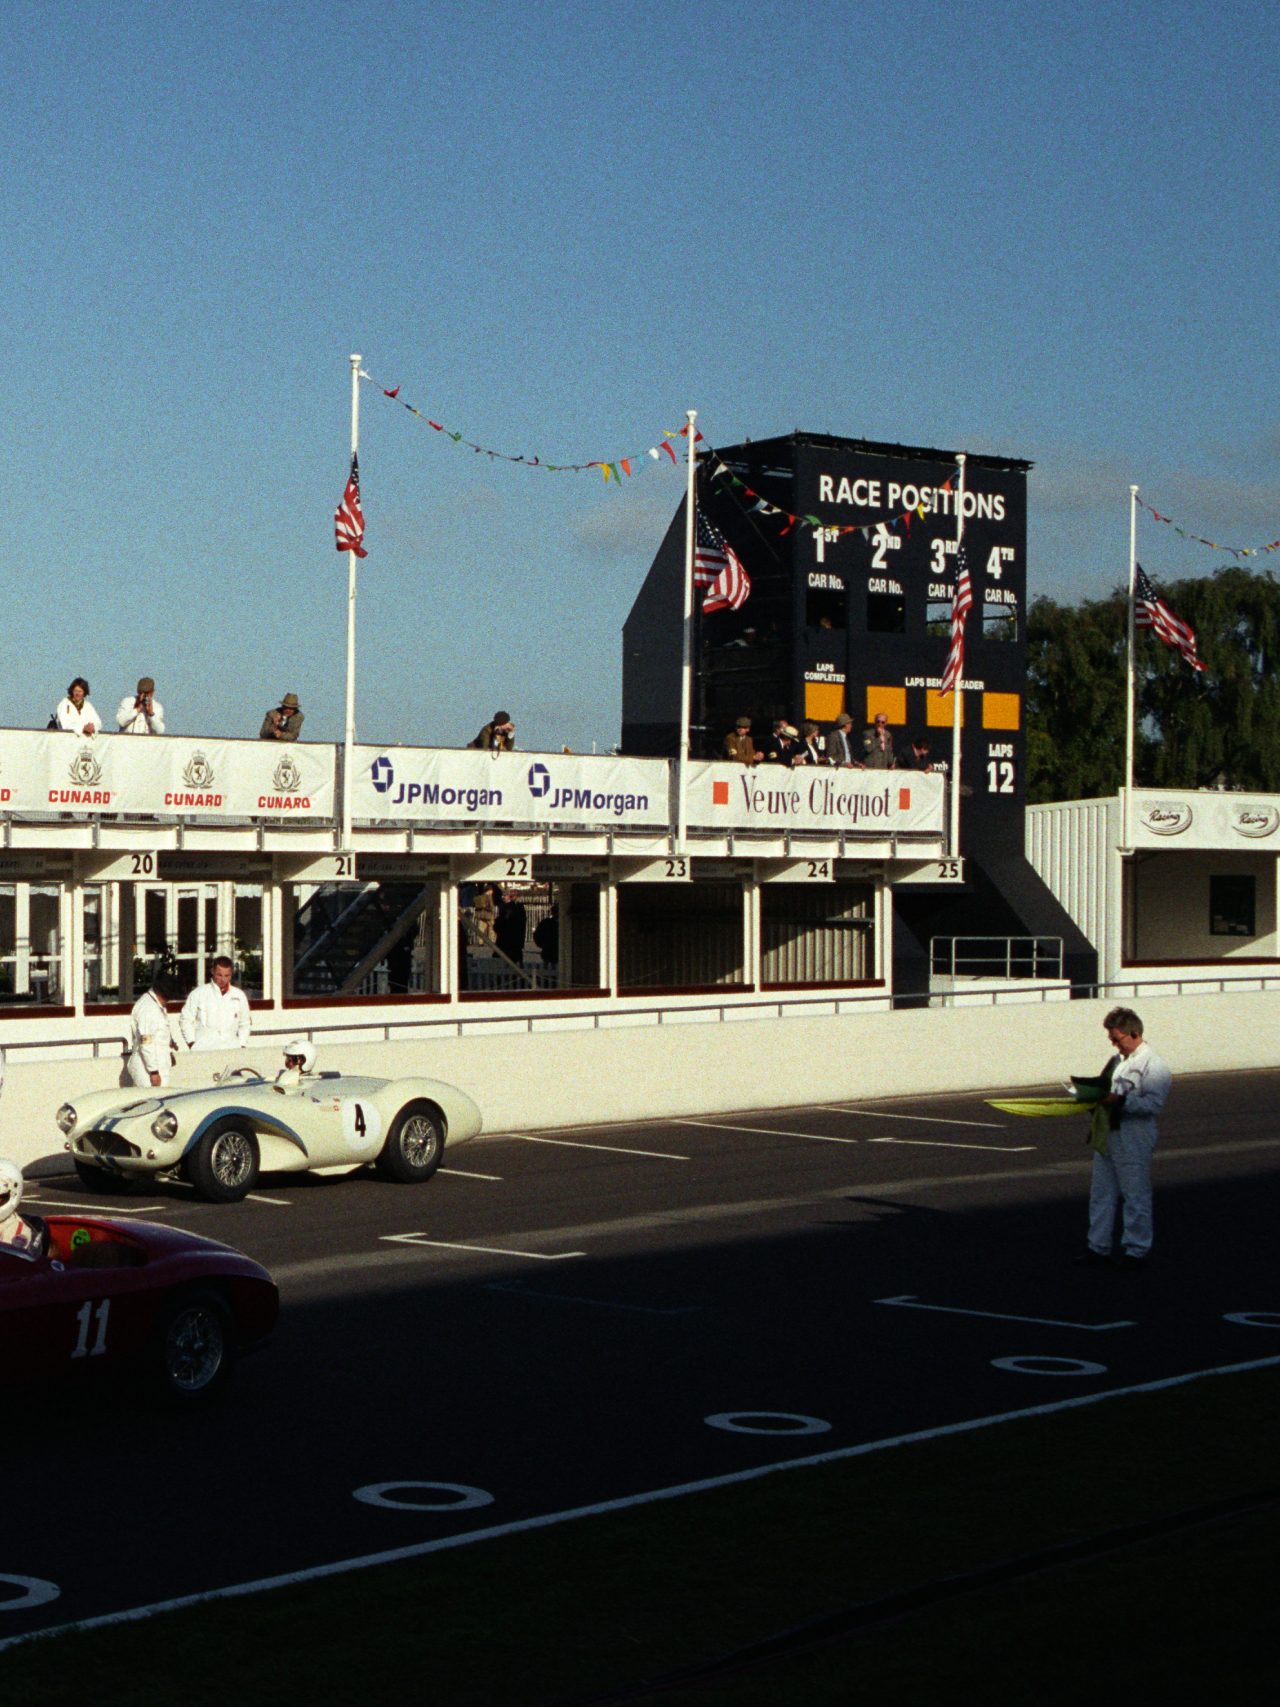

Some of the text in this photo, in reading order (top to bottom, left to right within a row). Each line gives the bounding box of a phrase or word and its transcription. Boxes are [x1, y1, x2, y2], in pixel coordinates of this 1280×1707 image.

[819, 474, 1006, 521] RACE POSITIONS
[986, 546, 1015, 580] 4TH
[808, 573, 827, 588] CAR
[868, 578, 887, 593] CAR
[928, 583, 946, 597] CAR
[984, 588, 1002, 603] CAR
[804, 671, 846, 683] COMPLETED
[816, 663, 834, 672] LAPS
[905, 677, 925, 688] LAPS
[958, 680, 985, 690] EADER
[988, 743, 1014, 758] LAPS
[986, 761, 1015, 793] 12
[47, 789, 111, 805] CUNARD
[164, 792, 222, 808] CUNARD
[257, 795, 312, 810] CUNARD
[391, 783, 503, 813] JPMorgan
[549, 787, 649, 816] JPMorgan
[739, 774, 892, 824] Veuve Clicquot
[1149, 809, 1181, 827] Racing
[1239, 812, 1269, 829] Racing
[131, 853, 154, 876] 20
[334, 857, 352, 877] 21
[506, 856, 528, 877] 22
[665, 858, 687, 879] 23
[807, 860, 830, 879] 24
[937, 861, 959, 880] 25
[354, 1103, 367, 1138] 4
[70, 1299, 112, 1359] 11
